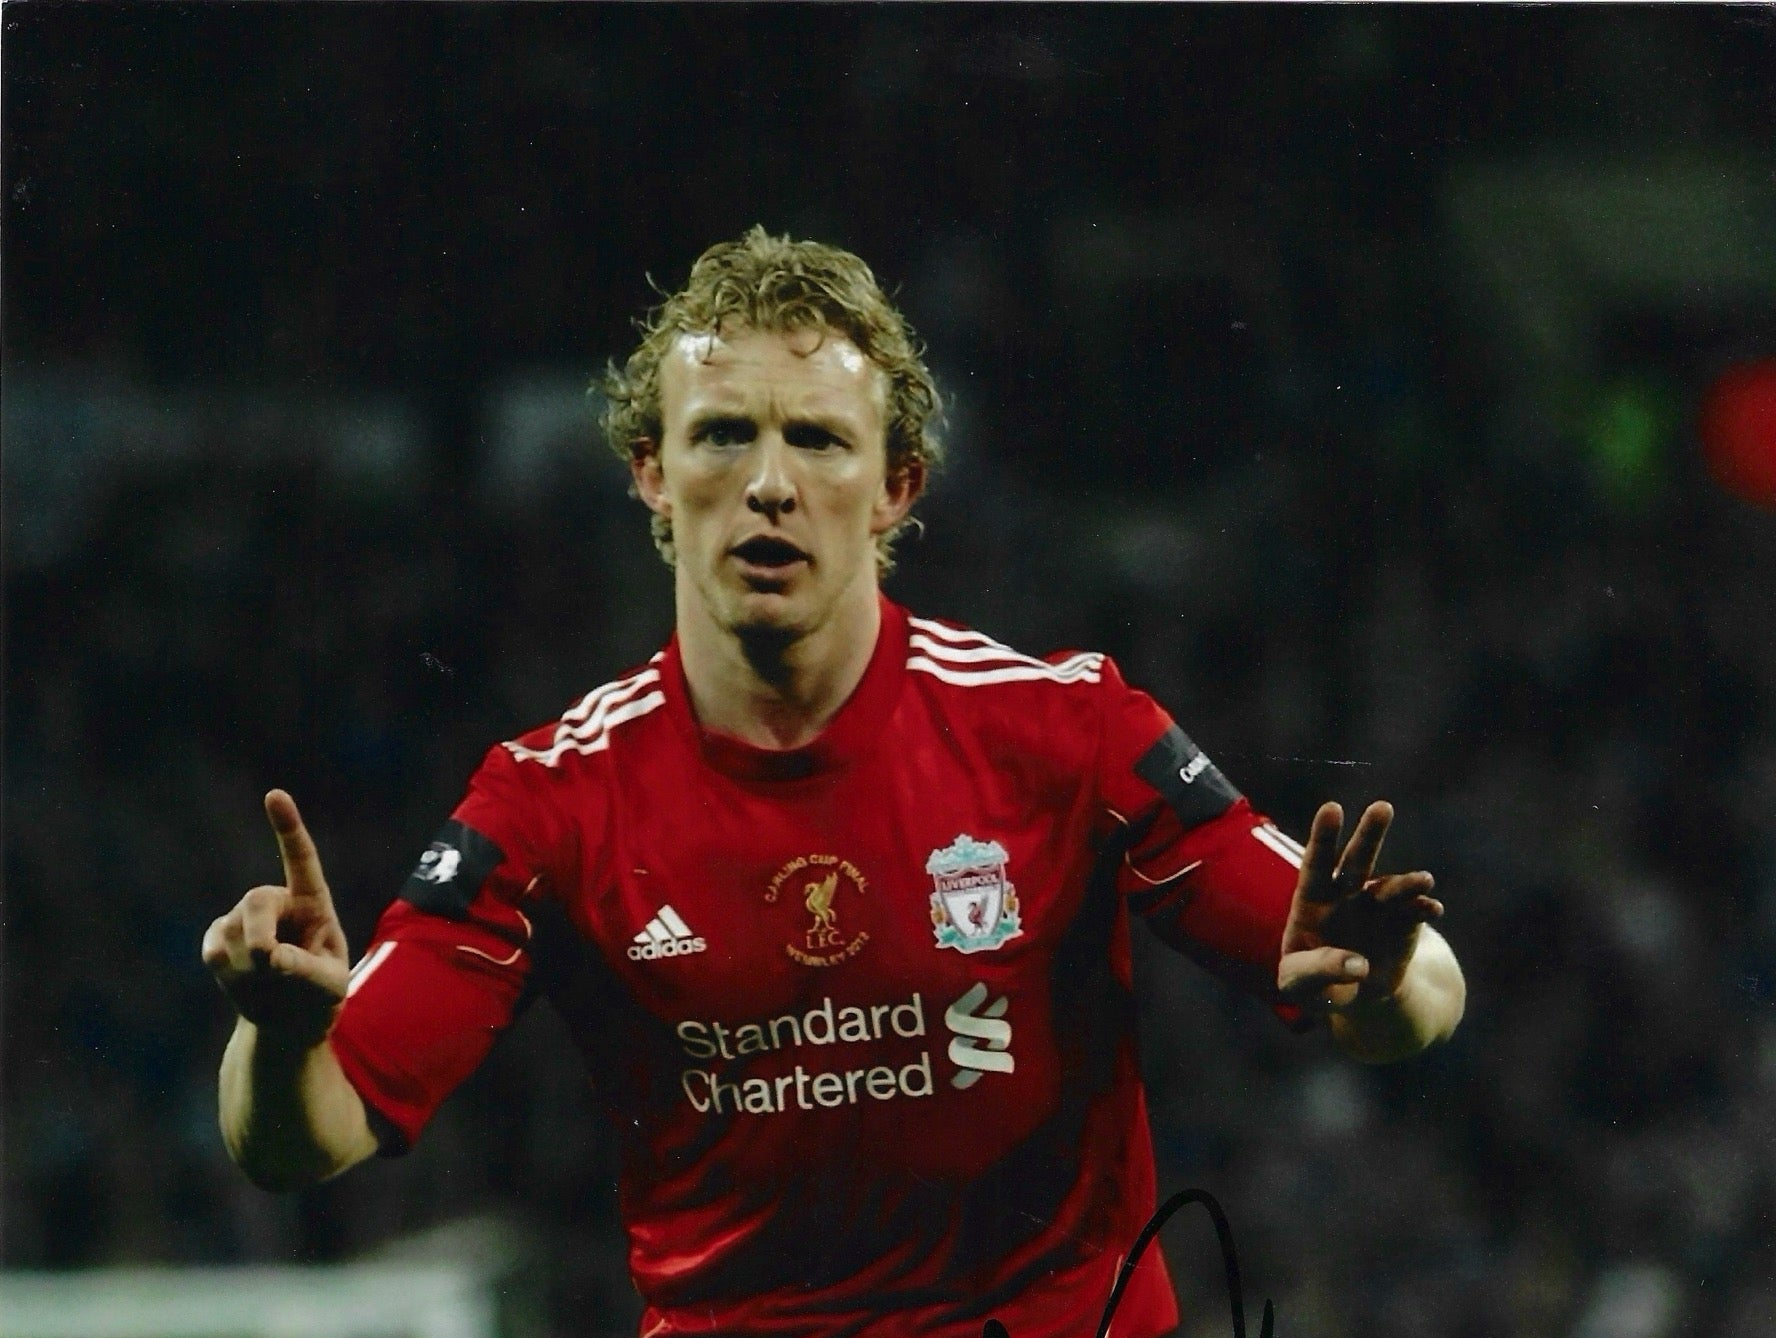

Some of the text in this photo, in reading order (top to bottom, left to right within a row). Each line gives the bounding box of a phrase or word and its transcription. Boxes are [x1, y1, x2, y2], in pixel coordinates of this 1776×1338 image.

[808, 854, 839, 865] CUP
[840, 861, 869, 893] FINAL
[940, 873, 999, 891] LIVERPOOL
[627, 936, 708, 961] adidas
[676, 993, 926, 1061] Standard
[681, 1051, 934, 1115] Chartered
